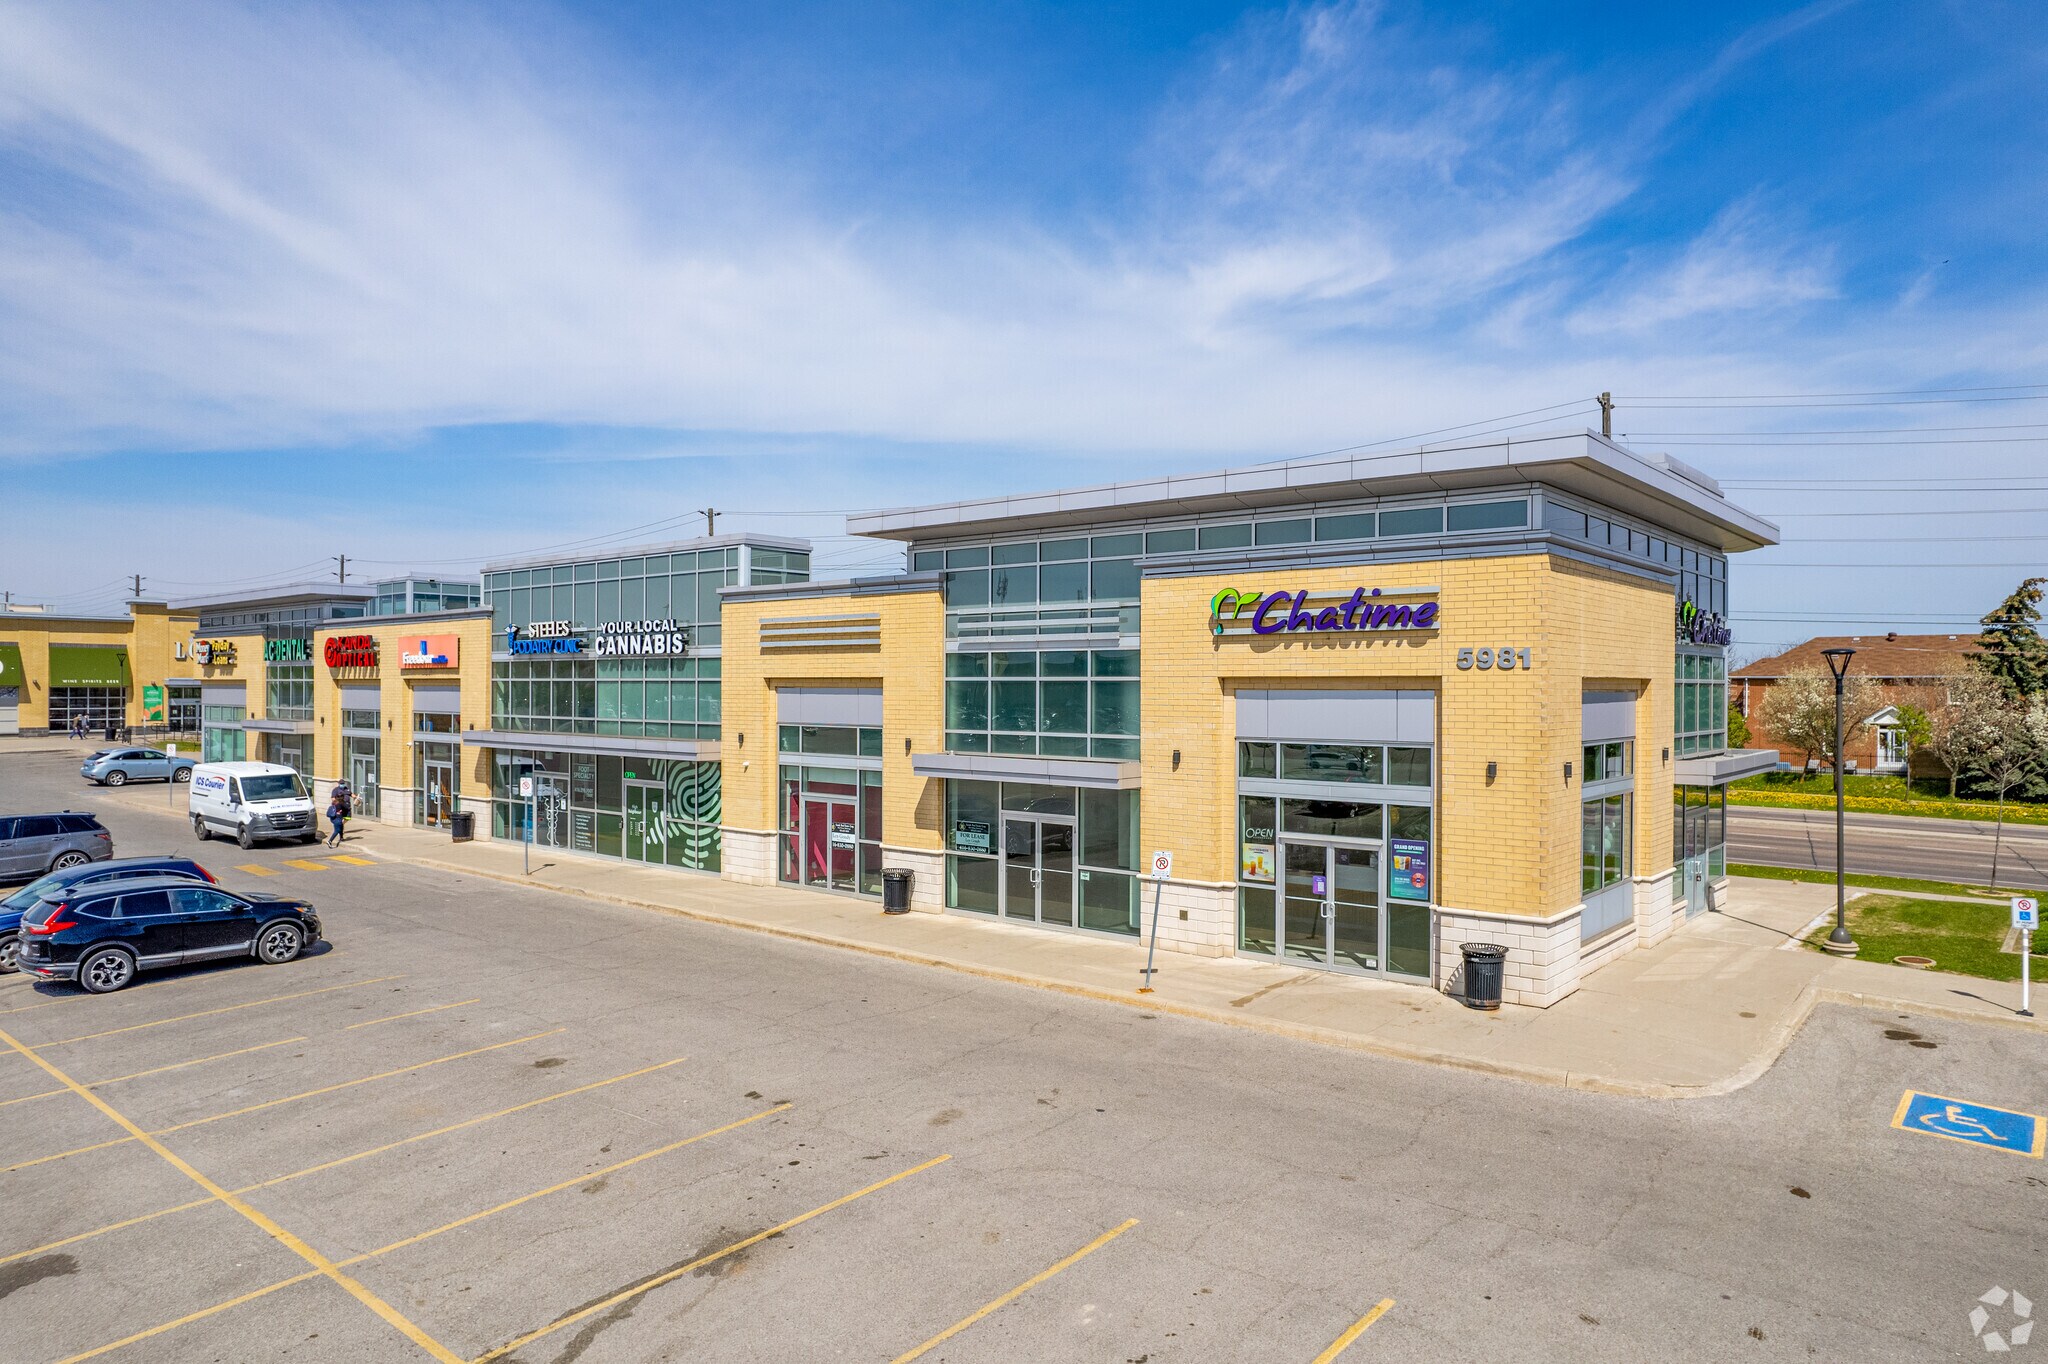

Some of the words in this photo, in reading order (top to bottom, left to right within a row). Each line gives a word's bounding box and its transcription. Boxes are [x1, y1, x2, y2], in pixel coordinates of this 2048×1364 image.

[1252, 587, 1439, 635] Chatime
[528, 620, 570, 638] STEELES
[601, 621, 633, 634] YOUR
[636, 619, 678, 633] LOCAL
[276, 639, 307, 660] DENTAL
[338, 636, 372, 650] KANDA
[513, 639, 552, 655] PODIATRY
[595, 633, 683, 655] CANNABIS
[336, 651, 376, 667] OPTICAL
[1456, 647, 1532, 670] 5981
[196, 776, 205, 786] ICS
[205, 778, 225, 790] Courier
[1245, 828, 1274, 838] OPEN
